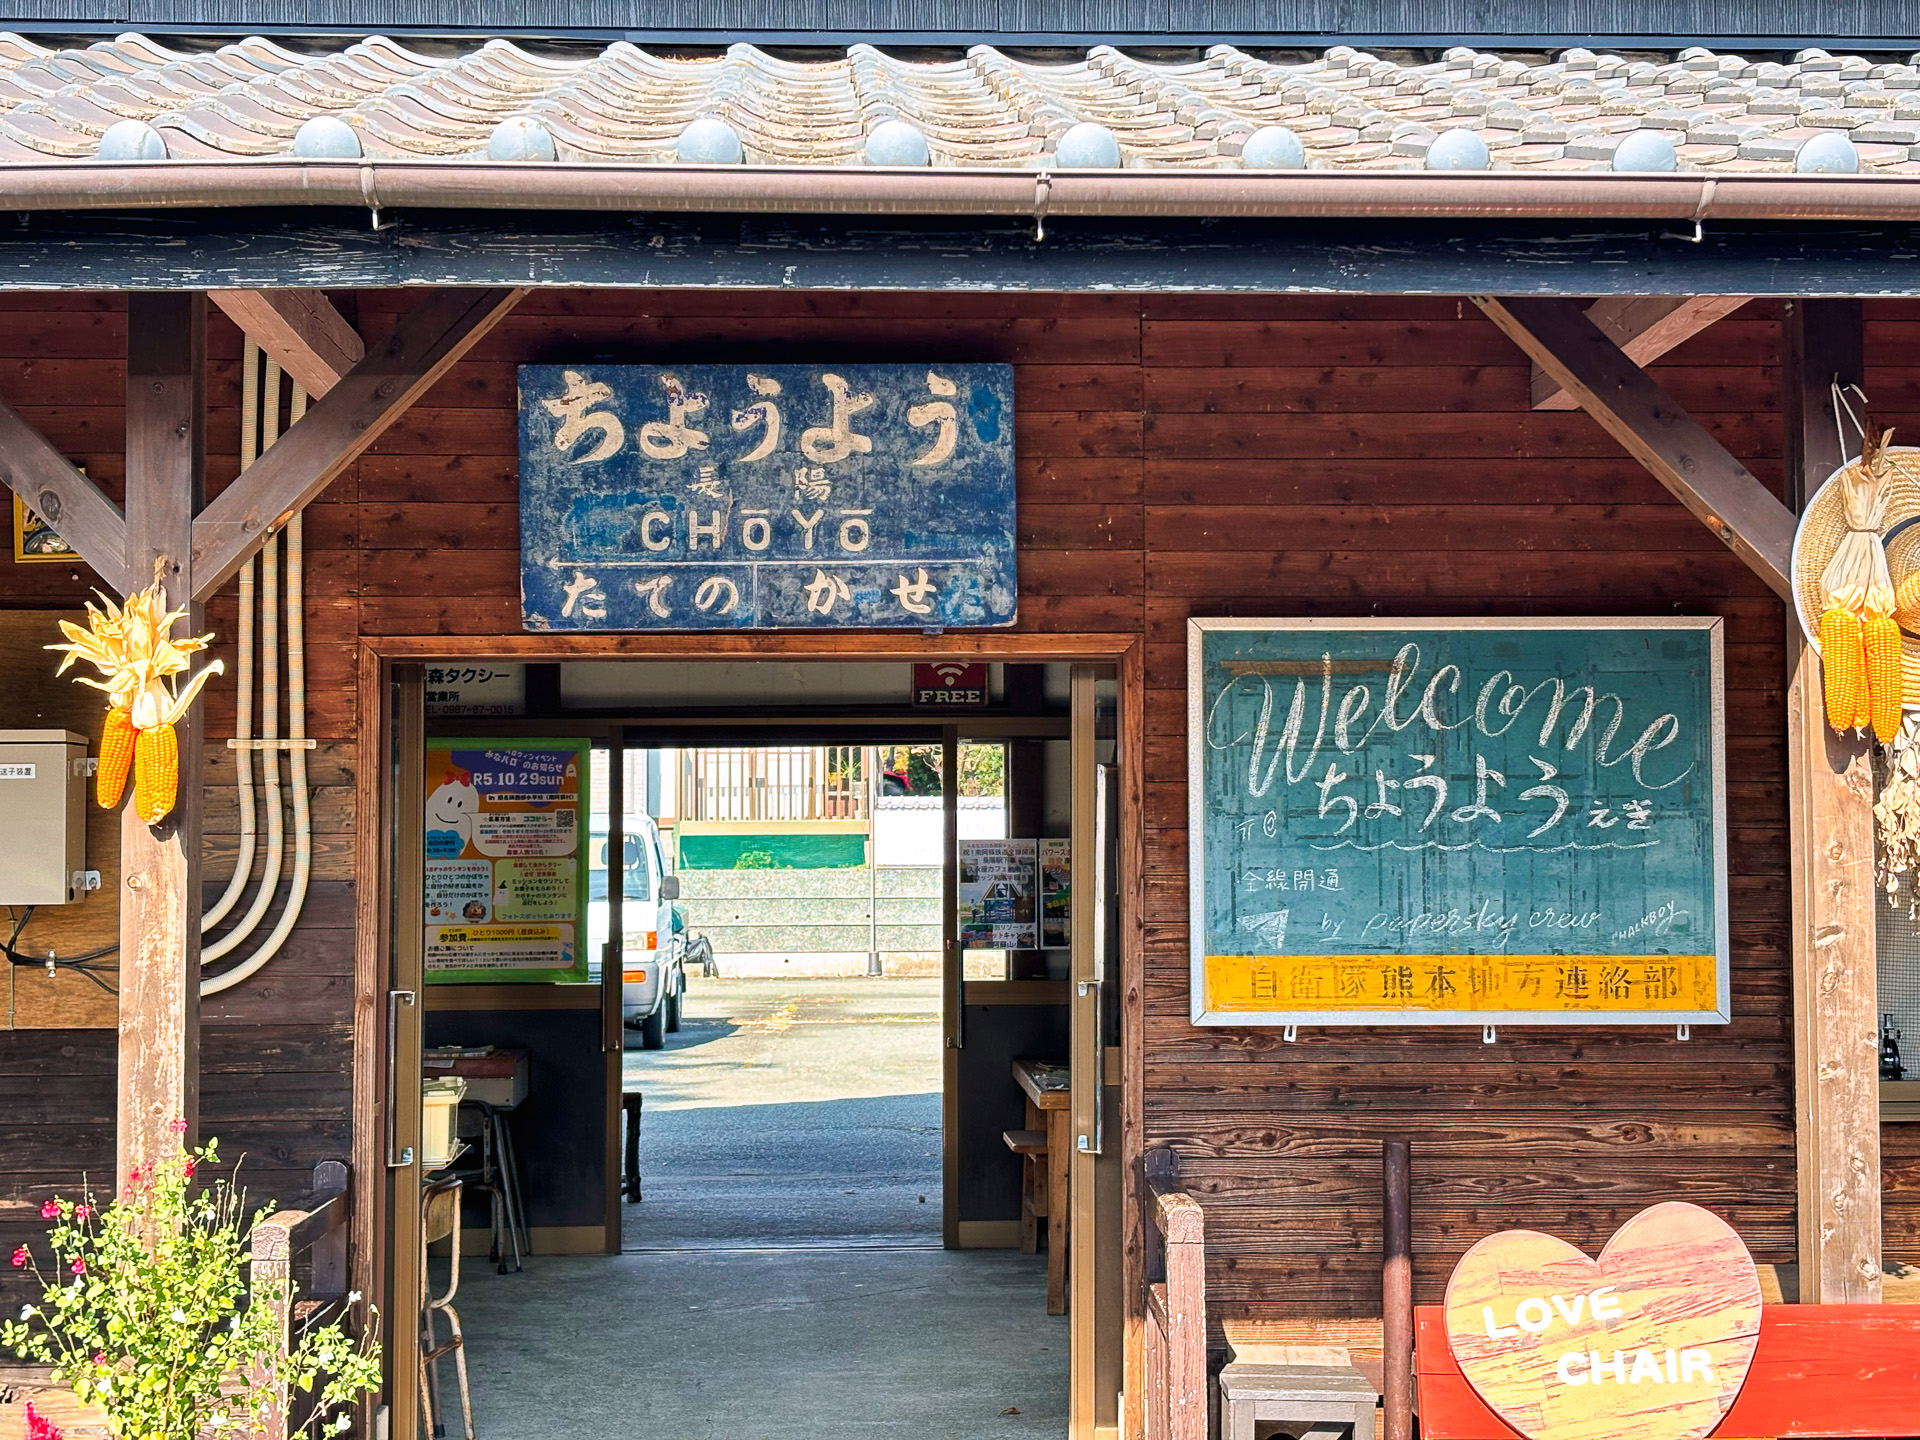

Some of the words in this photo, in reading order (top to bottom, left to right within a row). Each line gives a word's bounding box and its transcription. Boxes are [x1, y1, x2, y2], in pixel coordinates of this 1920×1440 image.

[686, 467, 831, 500] 長陽
[562, 571, 740, 618] たての
[804, 567, 937, 614] かせ
[428, 668, 510, 684] 森タクシー
[920, 691, 980, 703] FREE
[1207, 643, 1695, 798] Welcome
[1241, 869, 1343, 892] 全線開通
[440, 933, 467, 942] 参加費
[1320, 916, 1343, 941] by
[1482, 1285, 1623, 1340] LOVE
[1555, 1348, 1714, 1386] CHAIR
